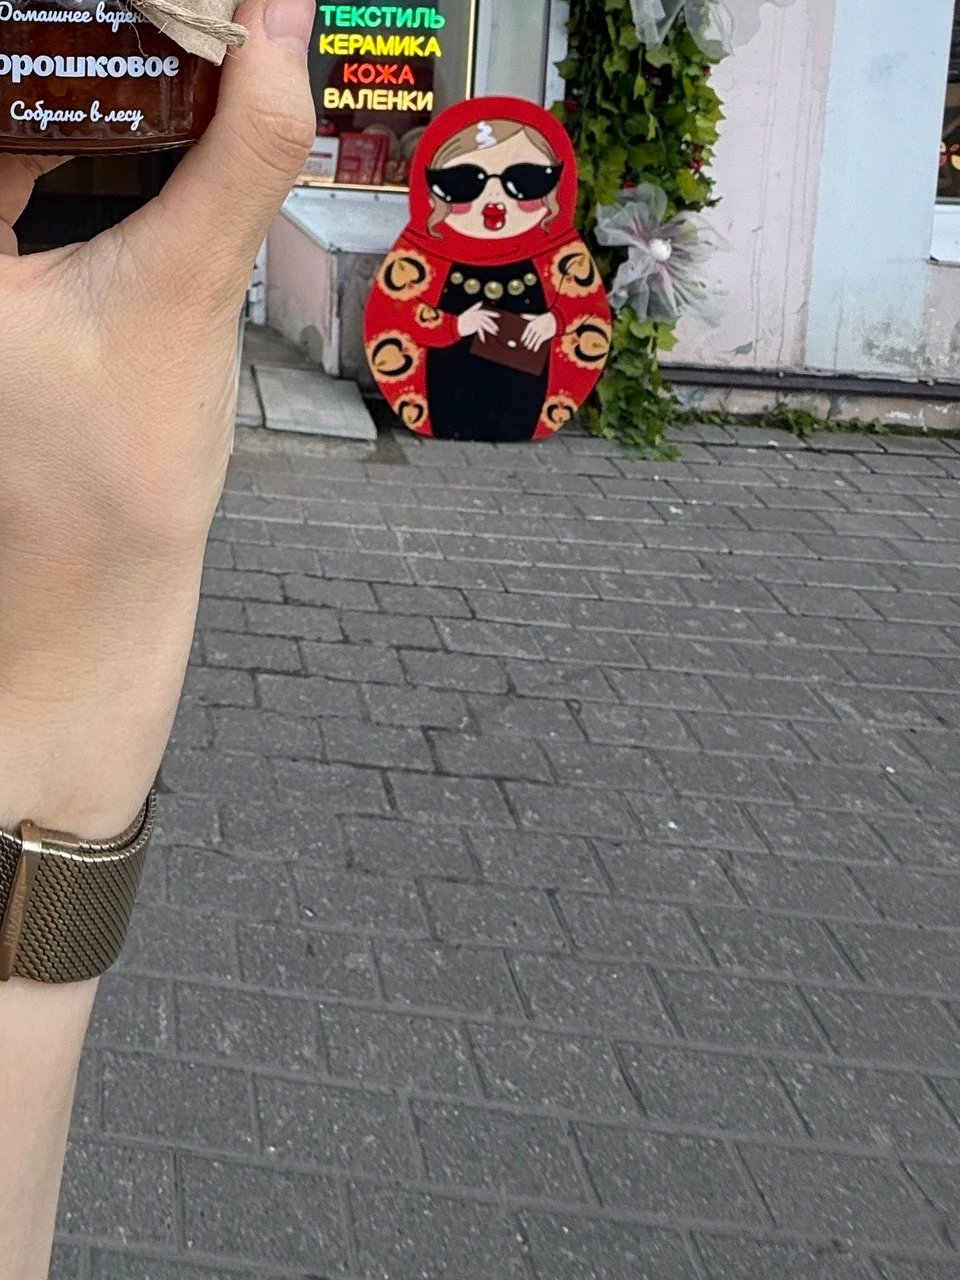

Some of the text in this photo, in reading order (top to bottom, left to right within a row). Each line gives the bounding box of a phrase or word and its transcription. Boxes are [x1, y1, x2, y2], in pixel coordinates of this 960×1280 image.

[96, 1, 151, 33] варен
[319, 4, 446, 29] ТЕКСТИЛЬ
[319, 34, 442, 58] КЕРАМИКА
[342, 61, 416, 86] КОЖА
[323, 86, 434, 112] ВАЛЕНКИ
[9, 100, 144, 132] Собрано в лесу
